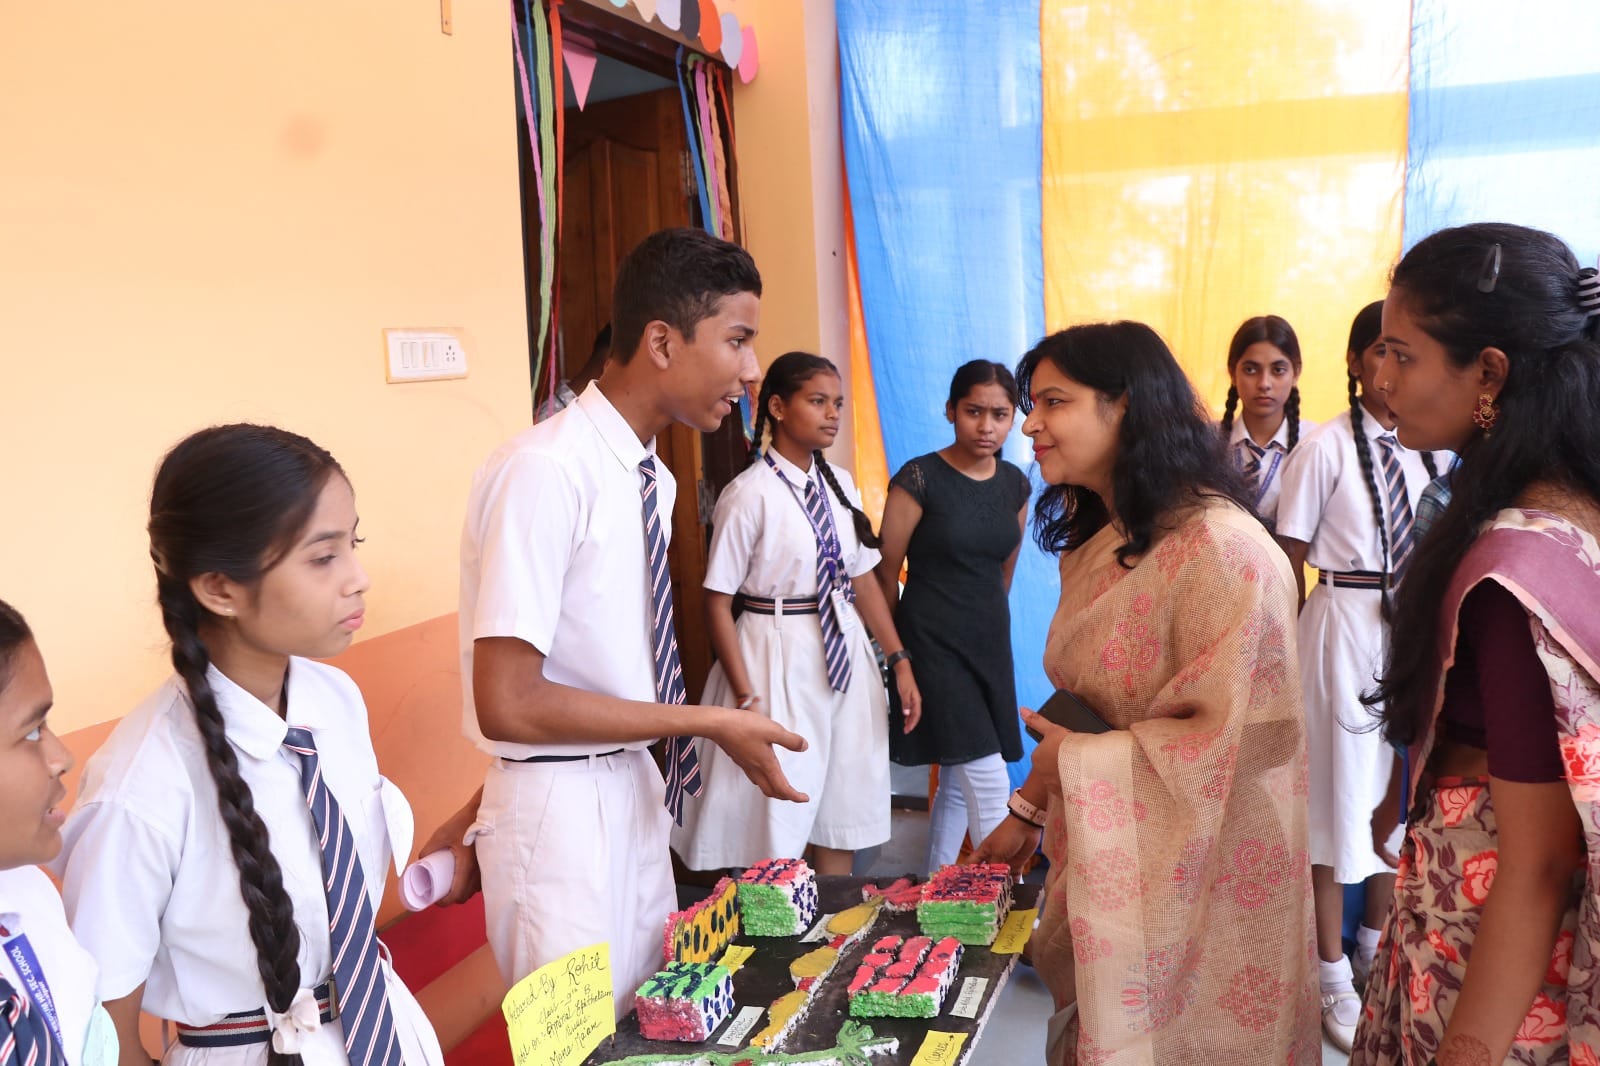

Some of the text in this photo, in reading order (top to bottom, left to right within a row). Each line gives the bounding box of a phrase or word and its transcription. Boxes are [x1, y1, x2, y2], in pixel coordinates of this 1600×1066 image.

[10, 945, 32, 976] SCHOOL
[26, 973, 39, 991] SEC.
[540, 972, 557, 1000] By
[561, 951, 607, 987] Rohit
[34, 988, 46, 1004] HR.
